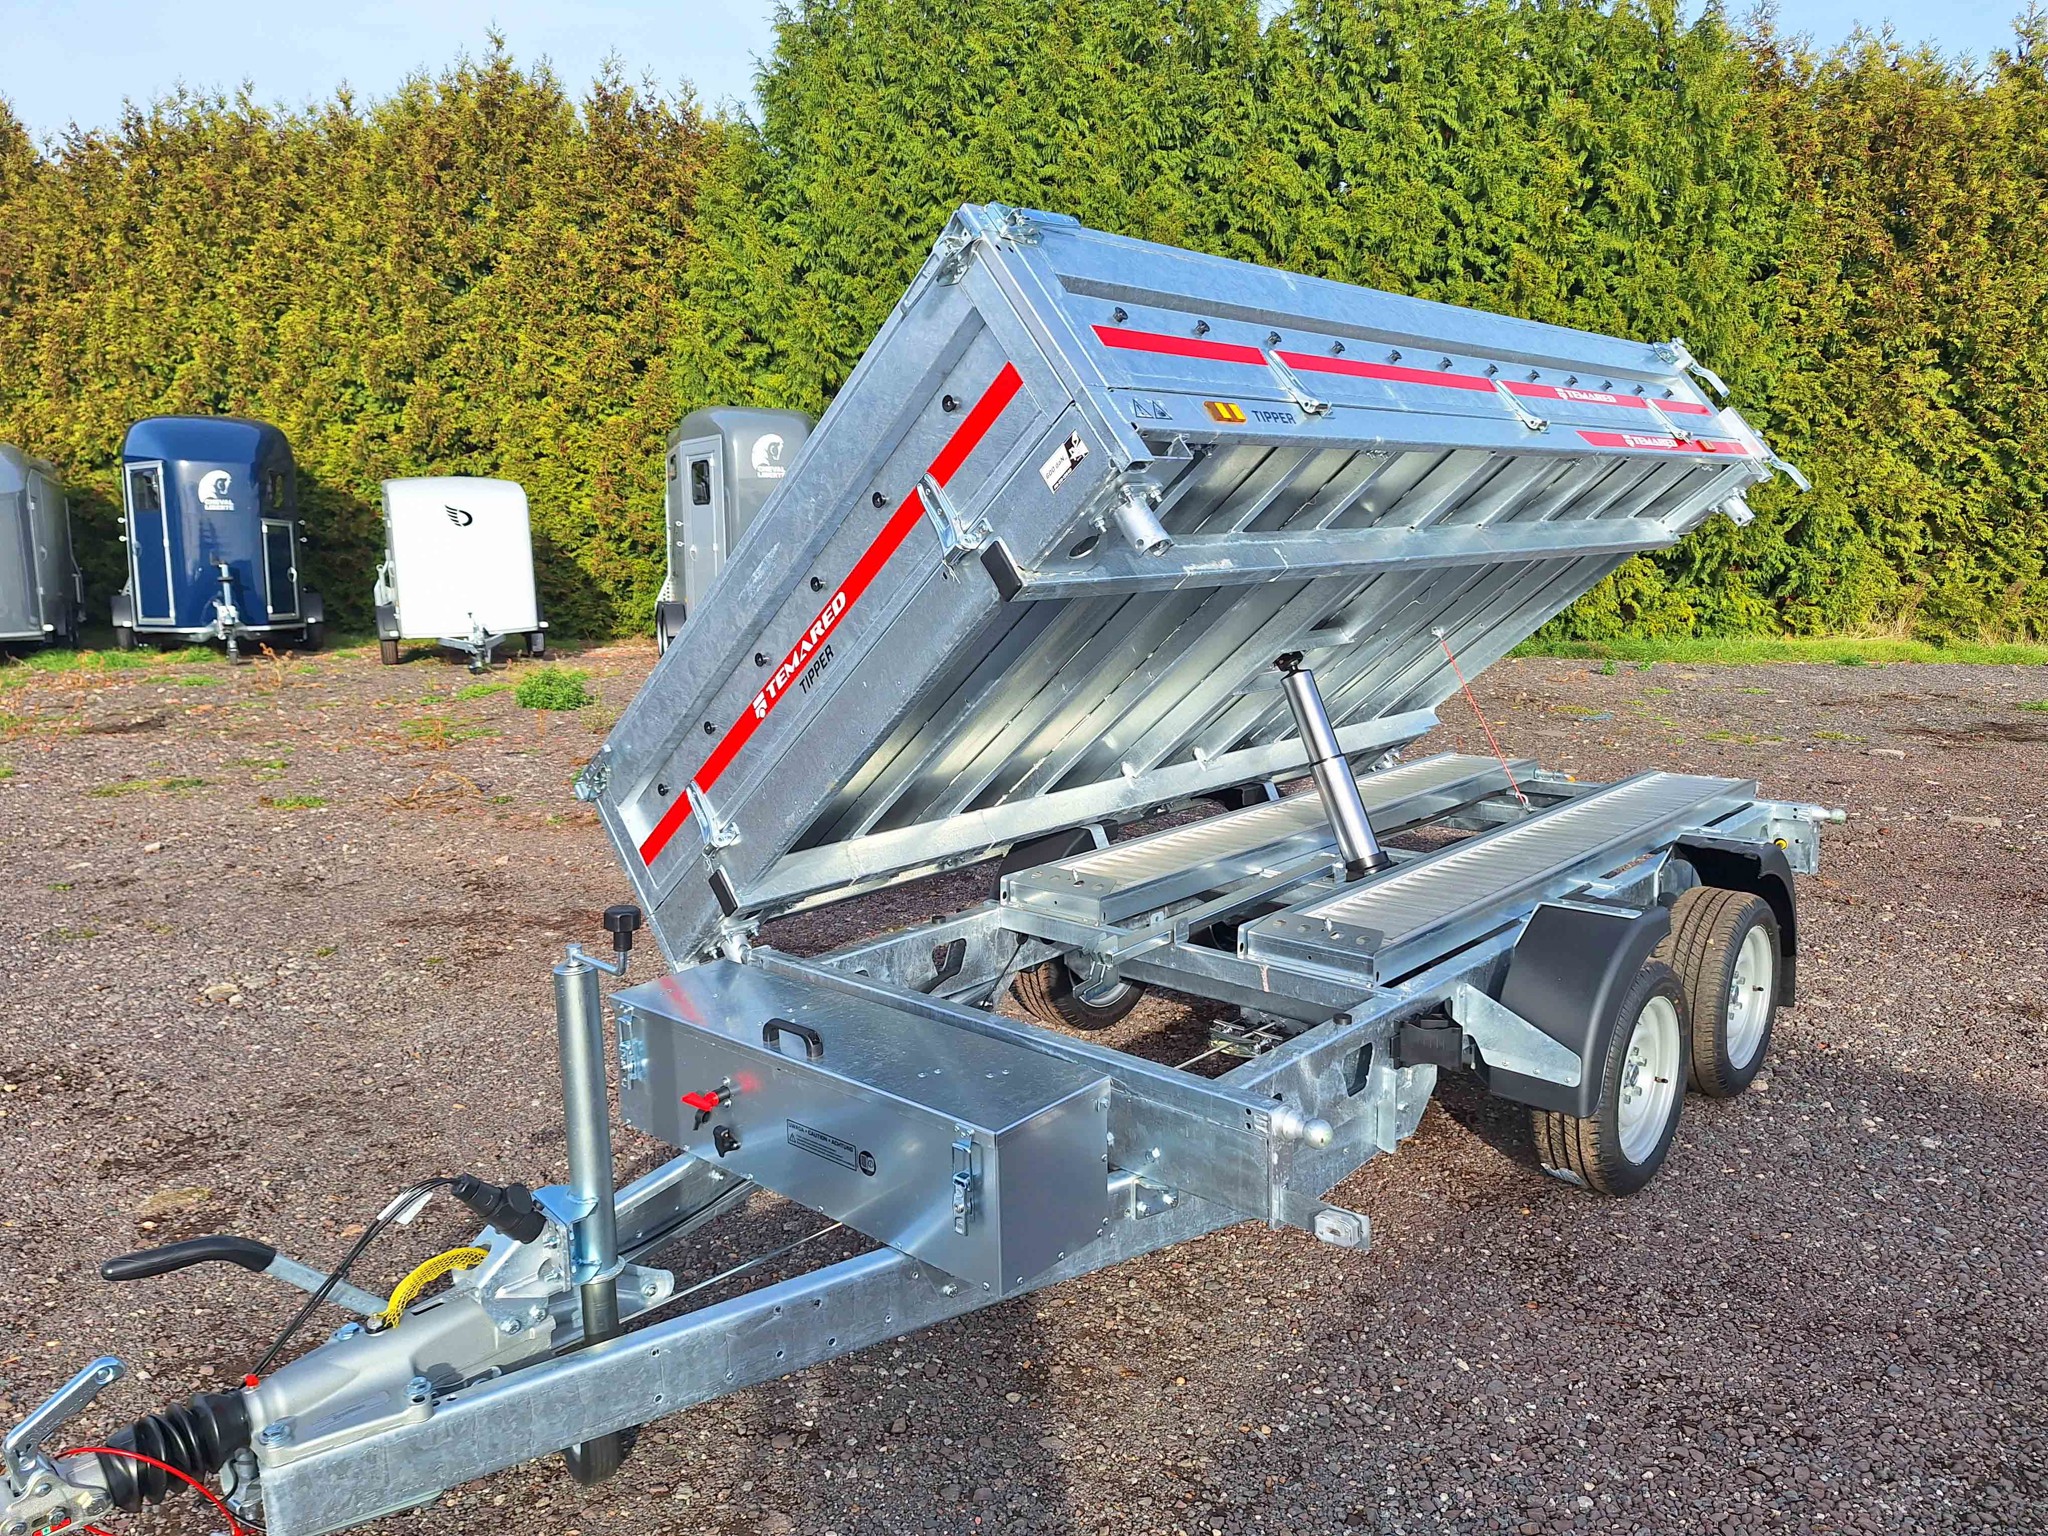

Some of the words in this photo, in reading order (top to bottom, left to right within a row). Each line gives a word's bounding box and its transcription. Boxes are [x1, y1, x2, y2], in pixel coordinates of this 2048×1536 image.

[1566, 389, 1617, 403] TEMARED
[1251, 410, 1297, 425] TIPPER
[1631, 436, 1679, 449] TEMARED
[766, 591, 847, 699] TEMARED
[798, 644, 835, 695] TIPPER
[808, 1128, 828, 1142] CAUTION
[831, 1140, 854, 1153] ACHTUNG
